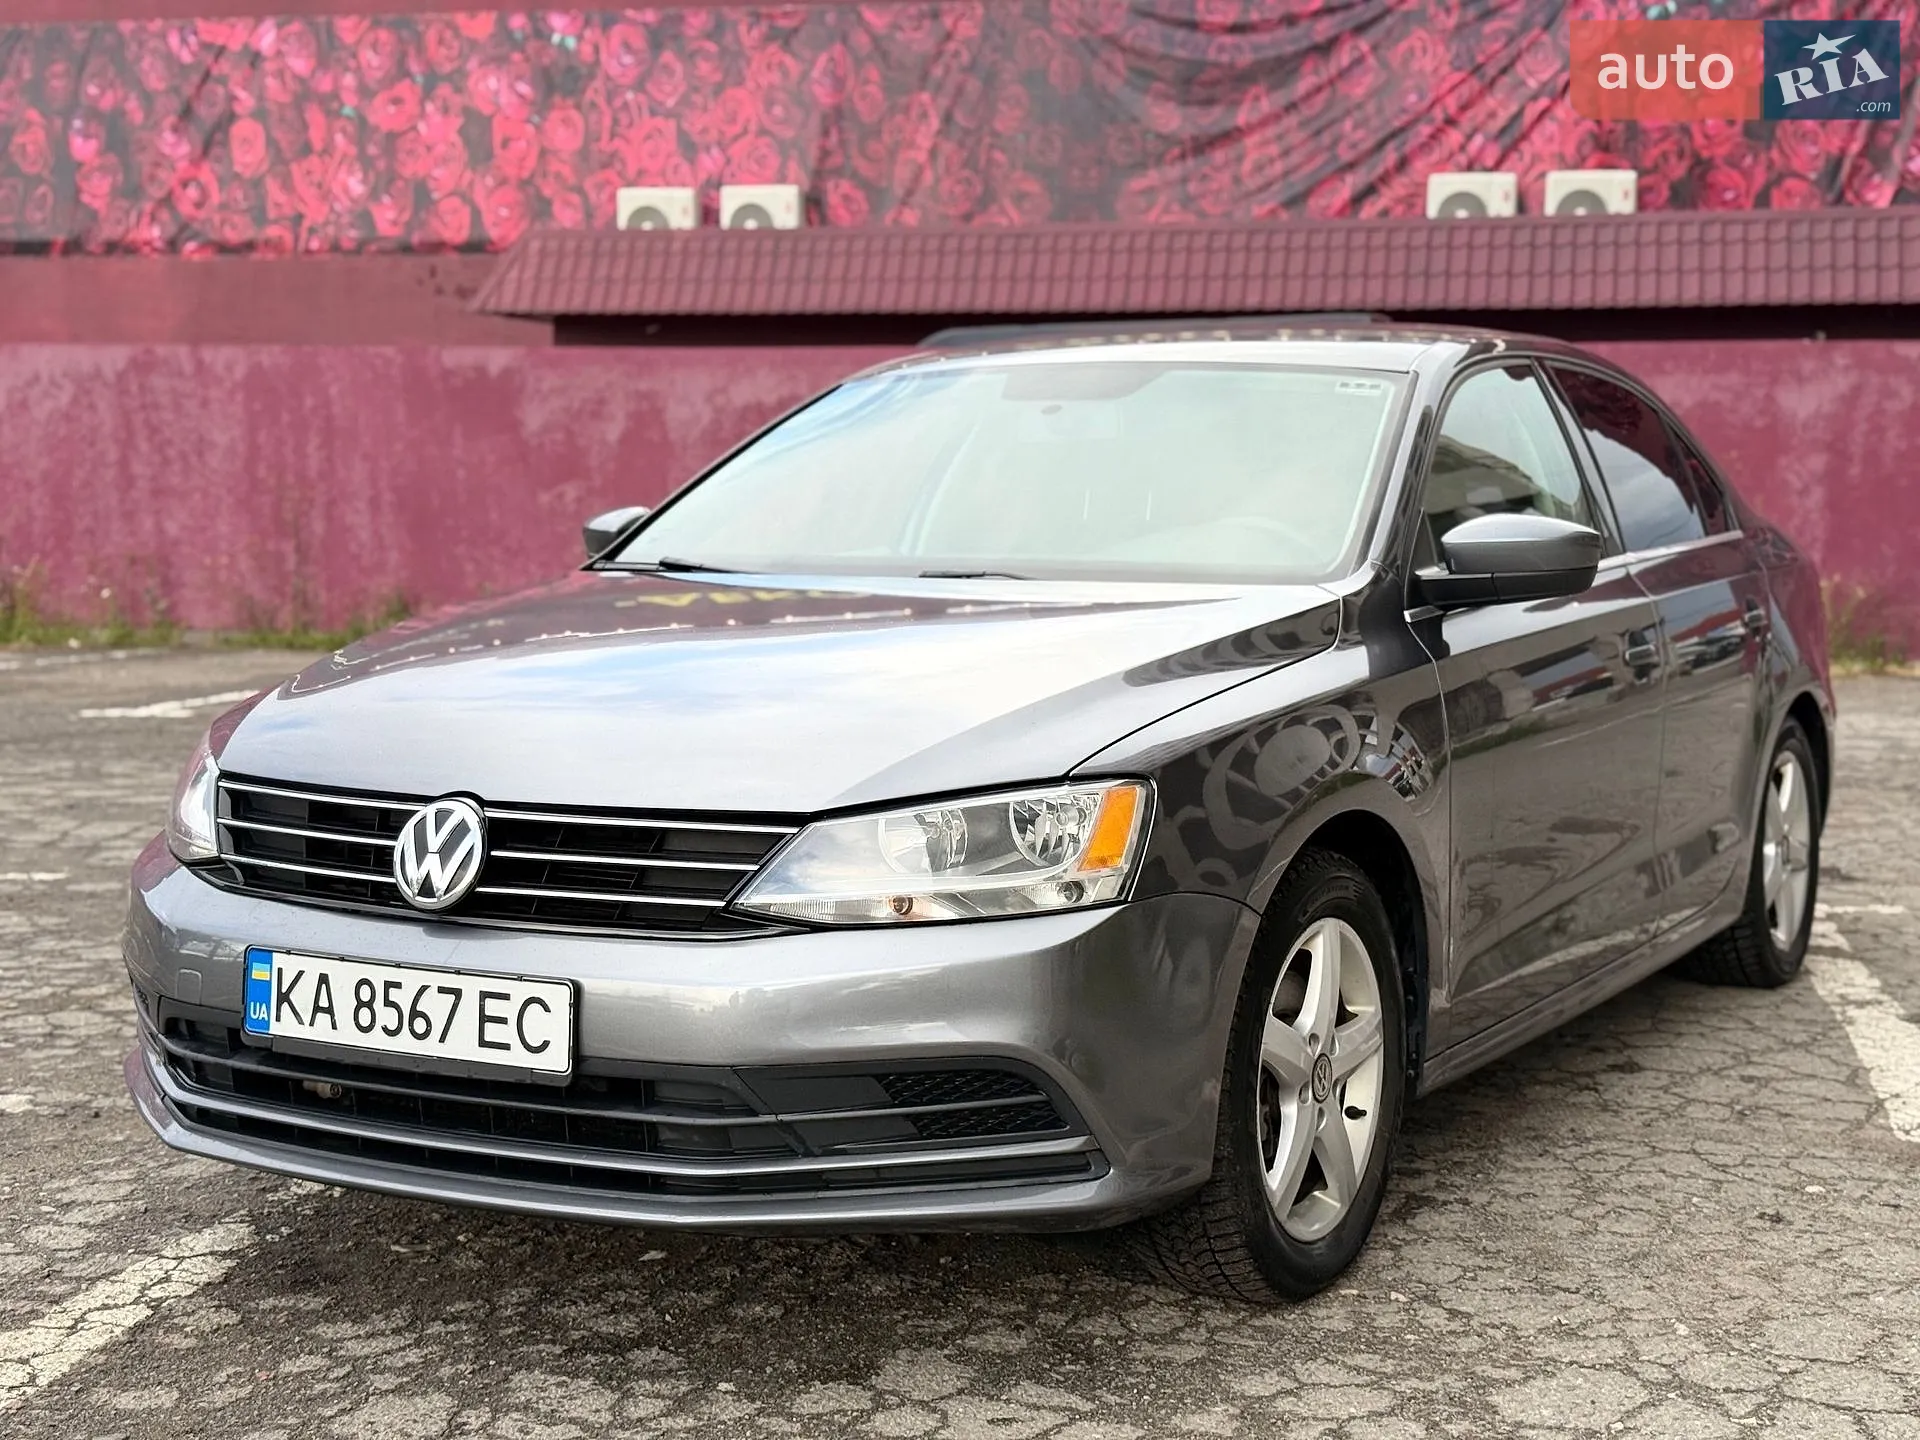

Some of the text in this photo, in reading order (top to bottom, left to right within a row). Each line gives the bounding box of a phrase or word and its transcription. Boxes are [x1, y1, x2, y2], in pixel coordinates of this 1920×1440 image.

[250, 1001, 269, 1022] UA
[275, 966, 552, 1054] KA 8567 EC
